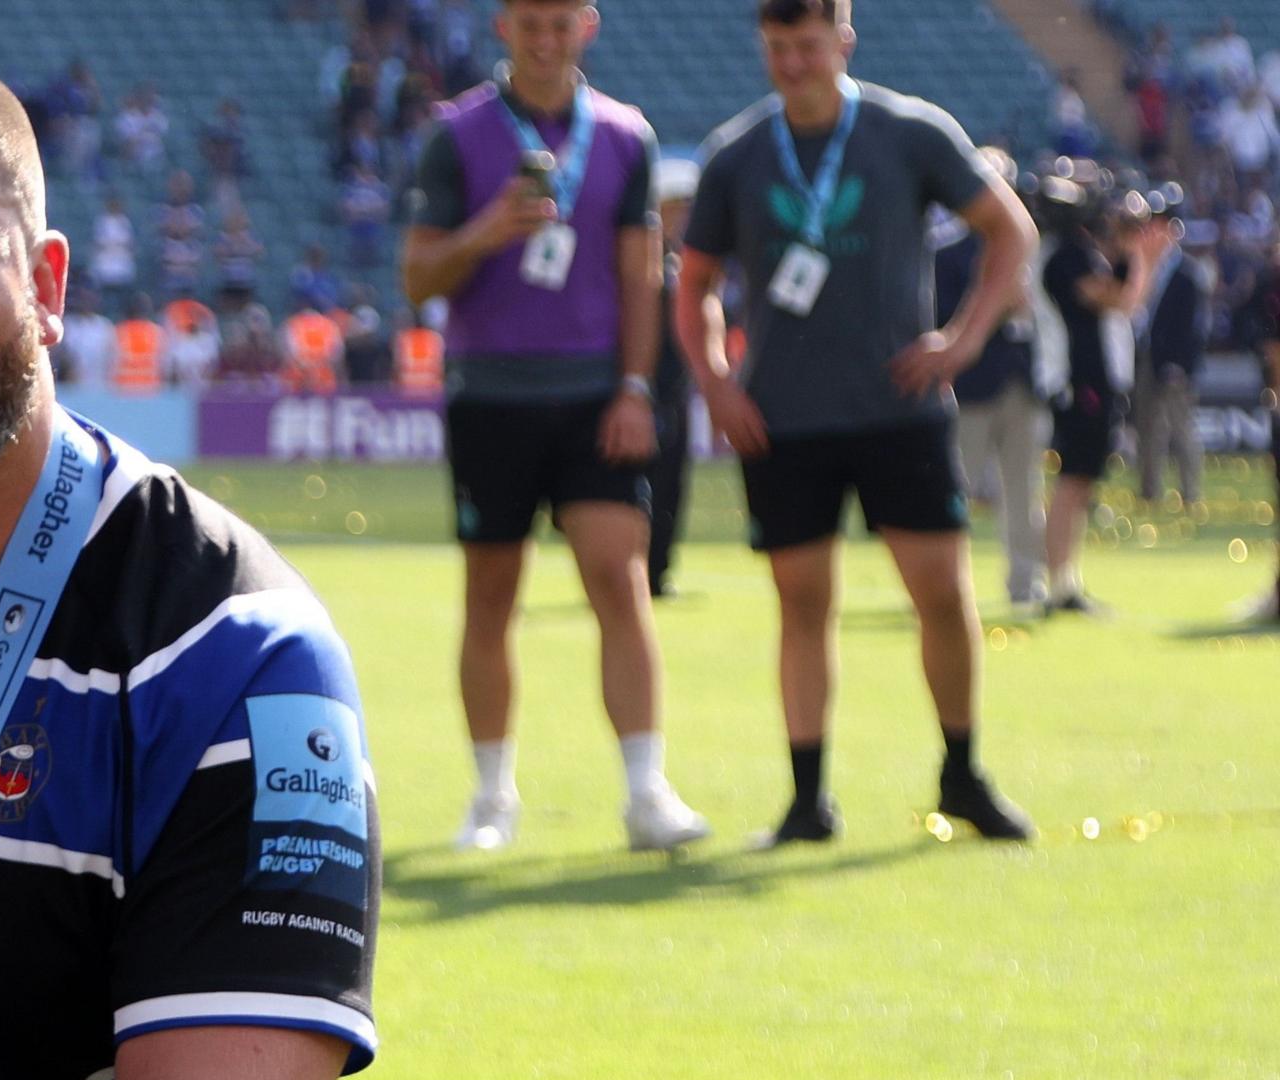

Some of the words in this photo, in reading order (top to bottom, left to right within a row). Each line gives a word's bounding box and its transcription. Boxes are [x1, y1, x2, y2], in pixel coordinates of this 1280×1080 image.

[266, 767, 364, 809] Gallagher
[259, 855, 324, 875] RUGBY
[262, 835, 364, 870] PREMIERSHIP
[242, 911, 285, 927] RUGBY
[288, 914, 337, 935] AGAINST
